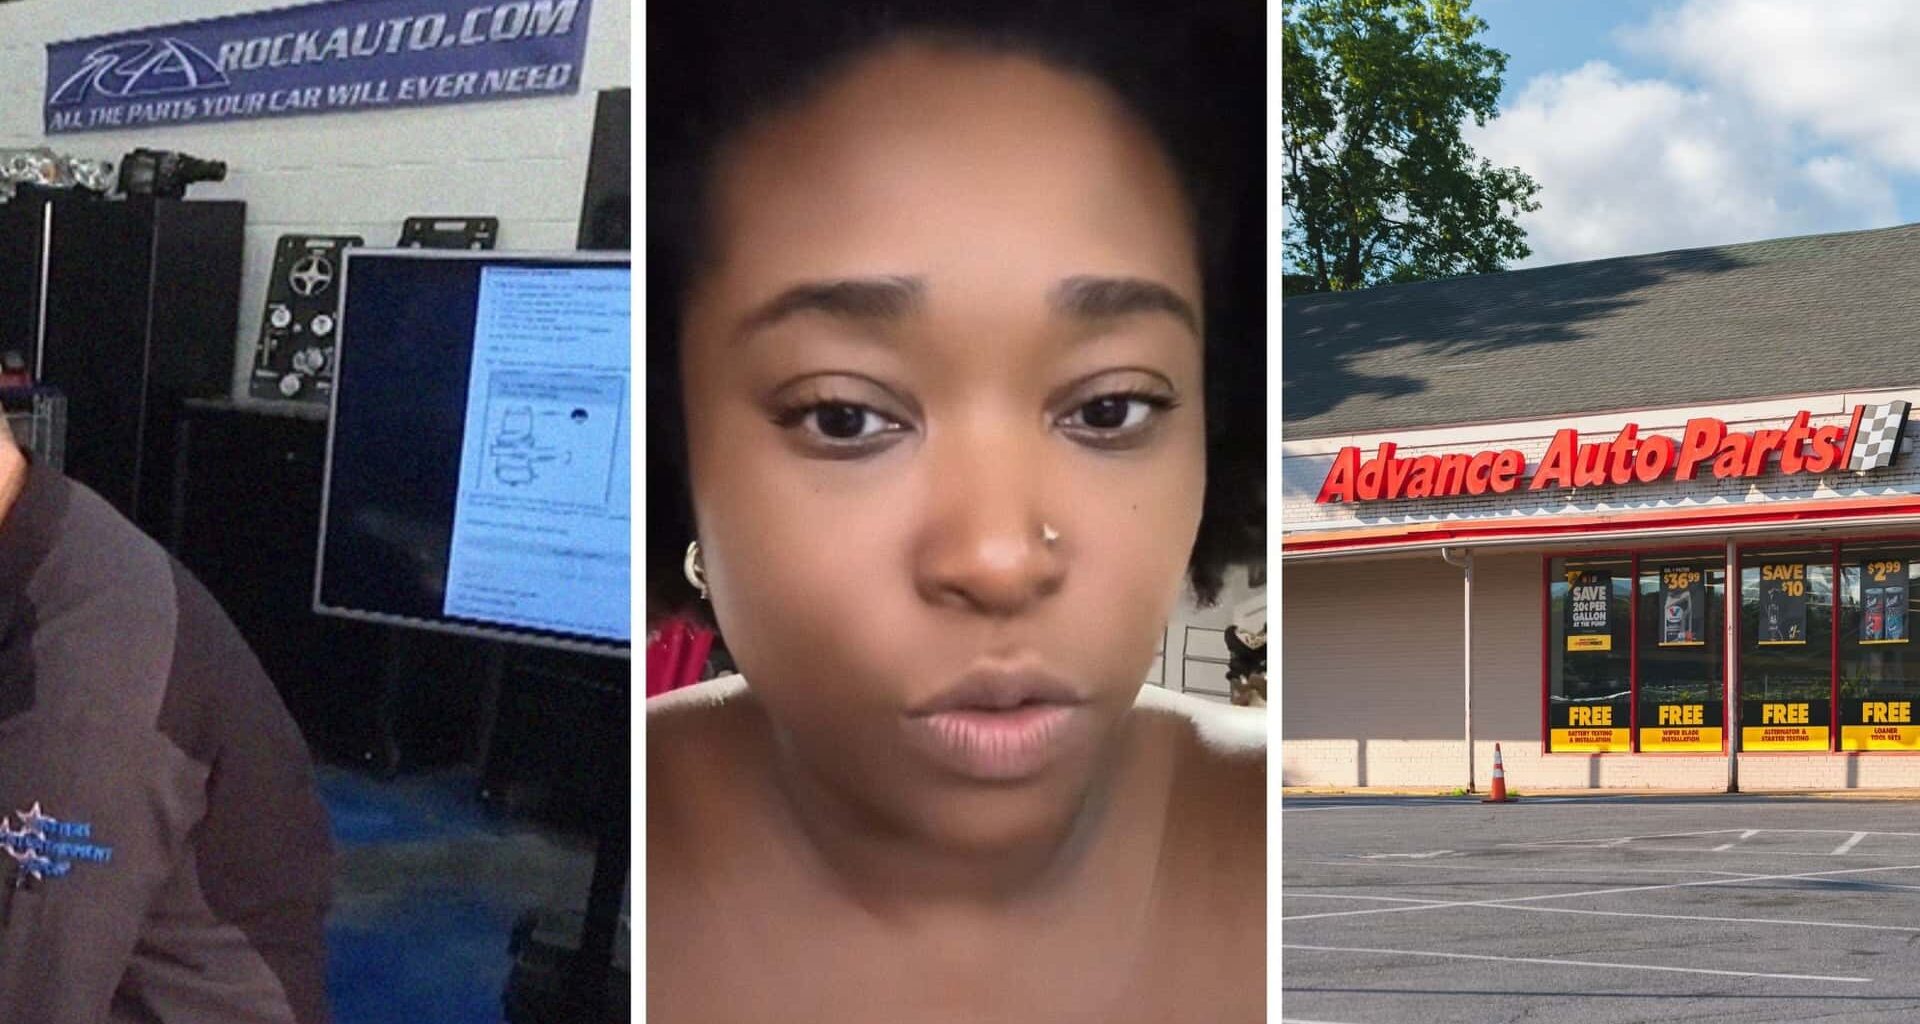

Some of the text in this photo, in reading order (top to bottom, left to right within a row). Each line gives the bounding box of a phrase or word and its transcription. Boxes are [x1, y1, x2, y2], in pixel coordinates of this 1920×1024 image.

[216, 0, 580, 72] ROCKAUTO.COM
[51, 63, 573, 129] ALL THE PARTS YOUR CAR WILL EVER NEED
[1315, 410, 1846, 504] Advance Auto Parts
[1762, 564, 1804, 580] SAVE
[1573, 586, 1607, 601] SAVE
[1782, 581, 1804, 596] $10
[1589, 601, 1607, 611] PER
[1573, 612, 1607, 621] GALLON
[1569, 706, 1612, 726] FREE
[1659, 705, 1704, 725] FREE
[1762, 703, 1809, 724] FREE
[1862, 701, 1911, 722] FREE
